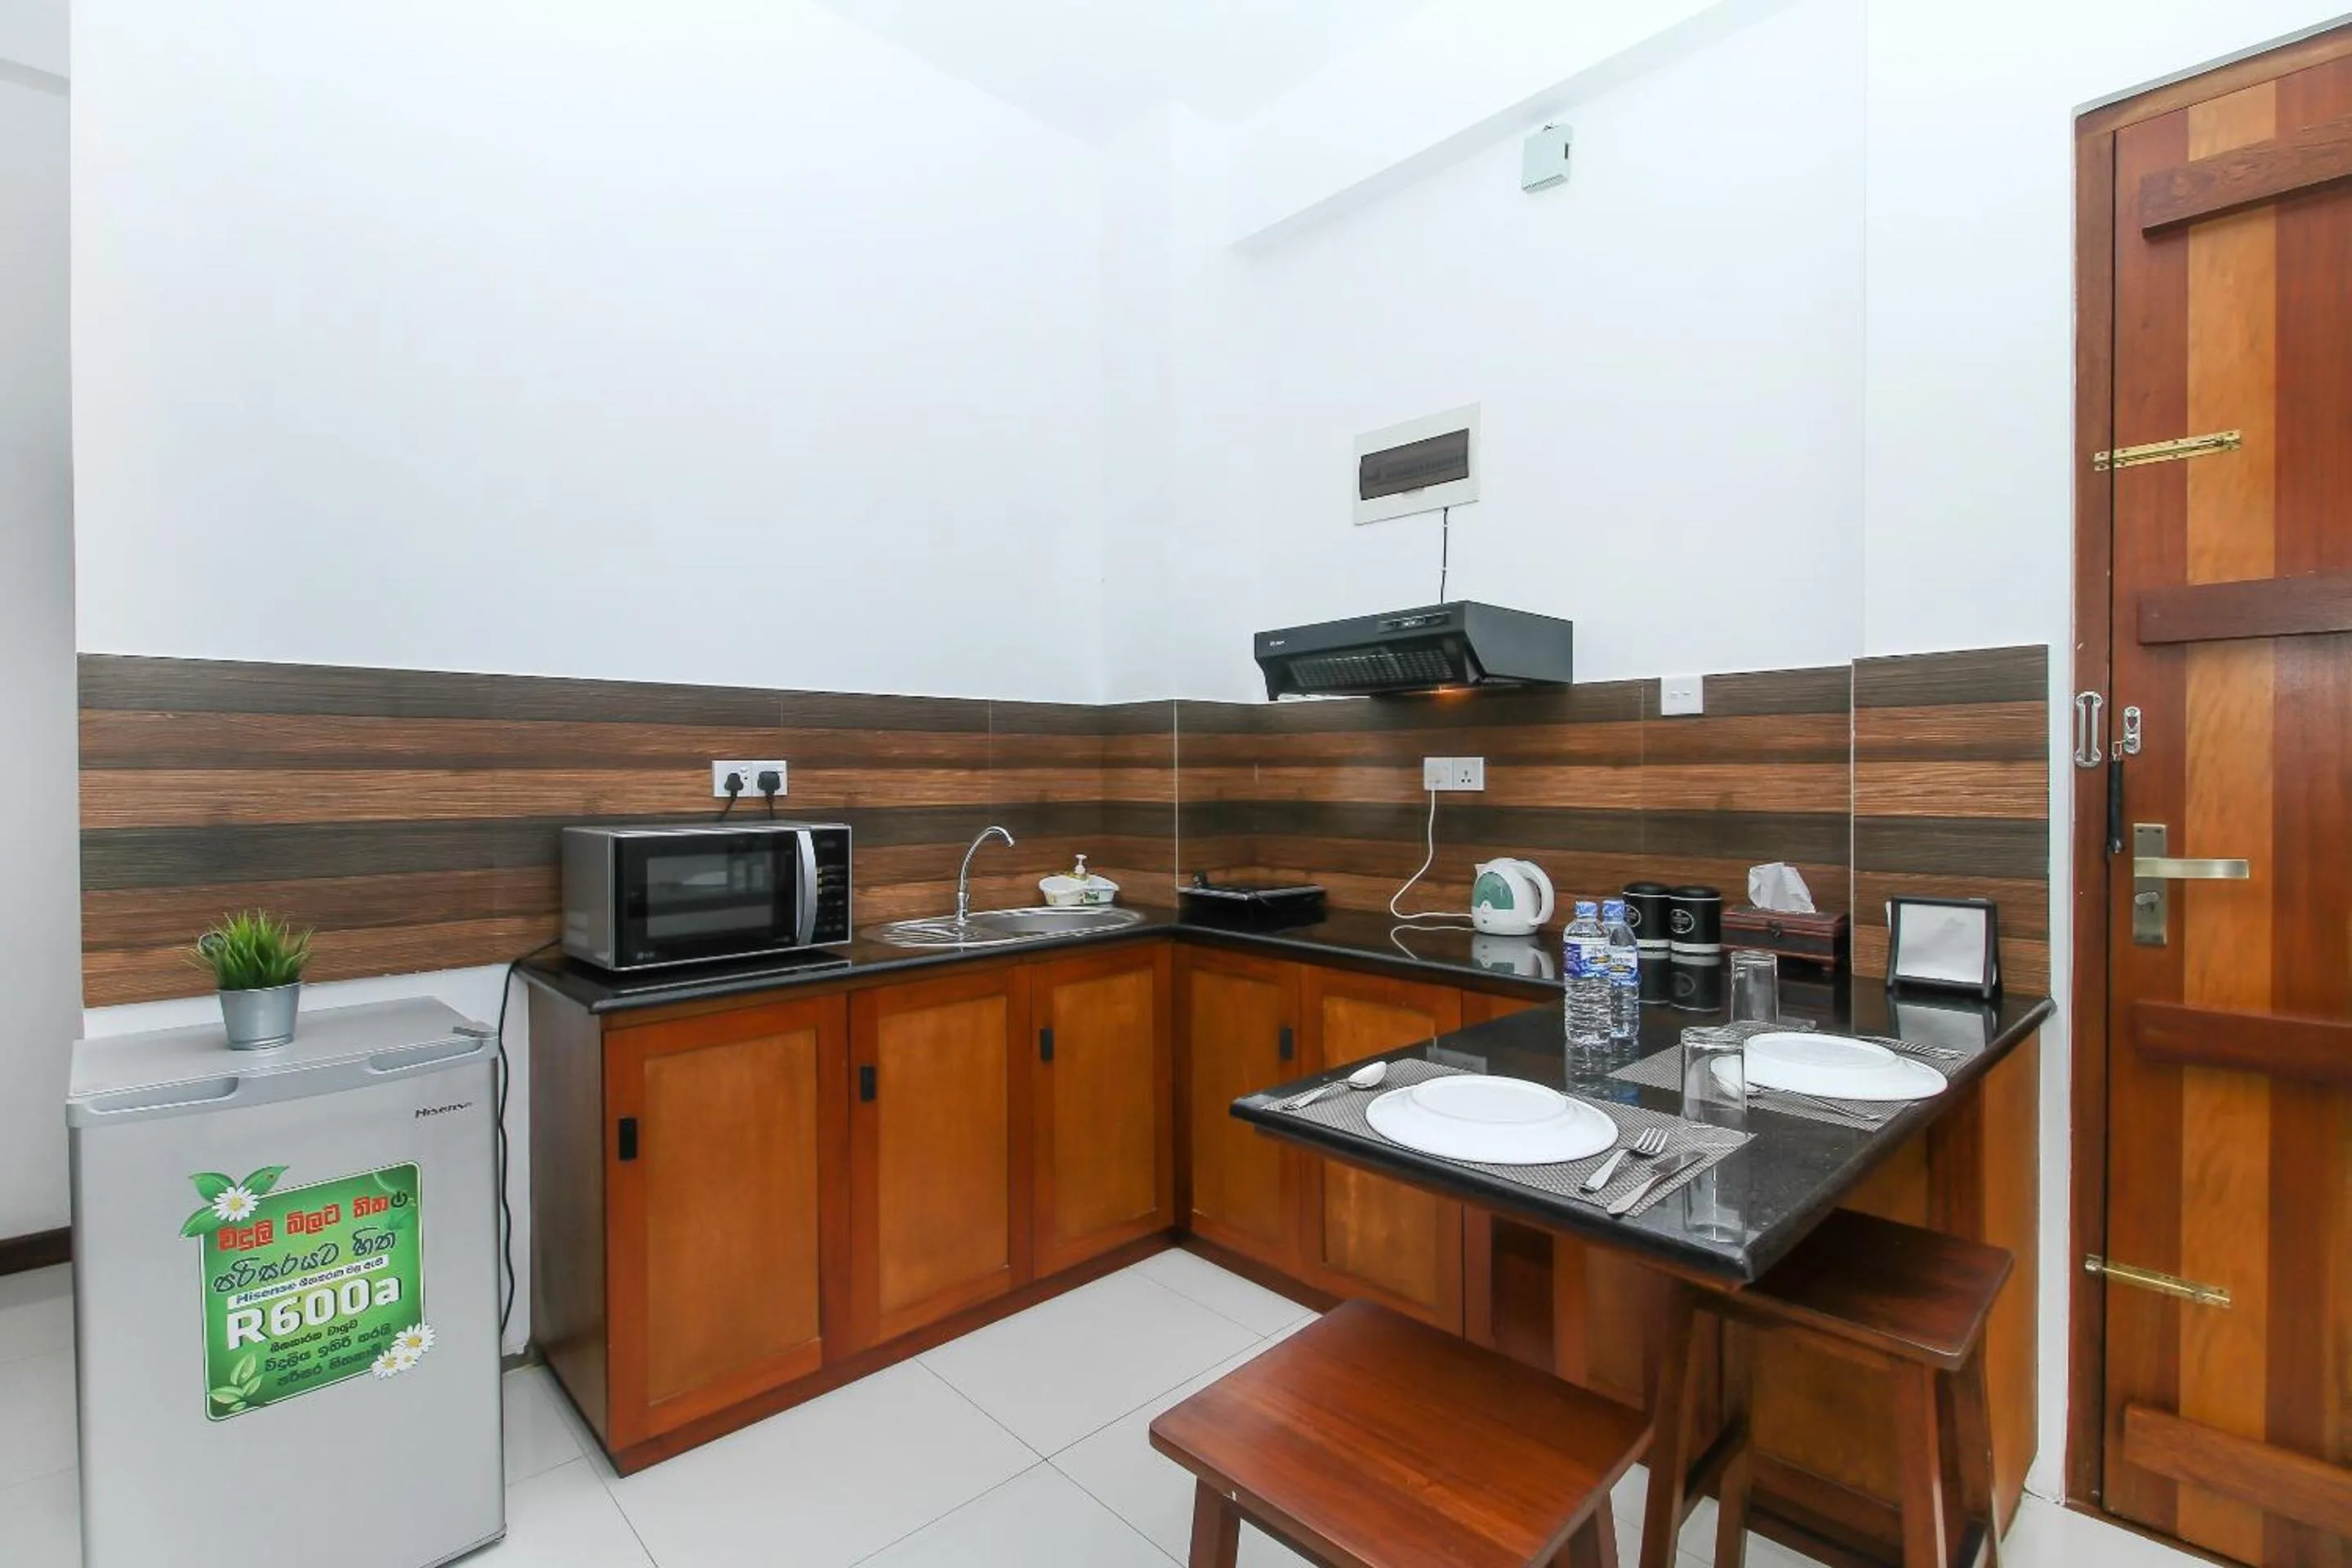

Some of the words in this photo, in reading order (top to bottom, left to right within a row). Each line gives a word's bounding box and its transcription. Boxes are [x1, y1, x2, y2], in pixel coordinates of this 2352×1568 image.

[212, 1243, 340, 1293] පරිසරයට
[352, 1227, 397, 1257] හිත
[227, 1275, 403, 1352] R600a
